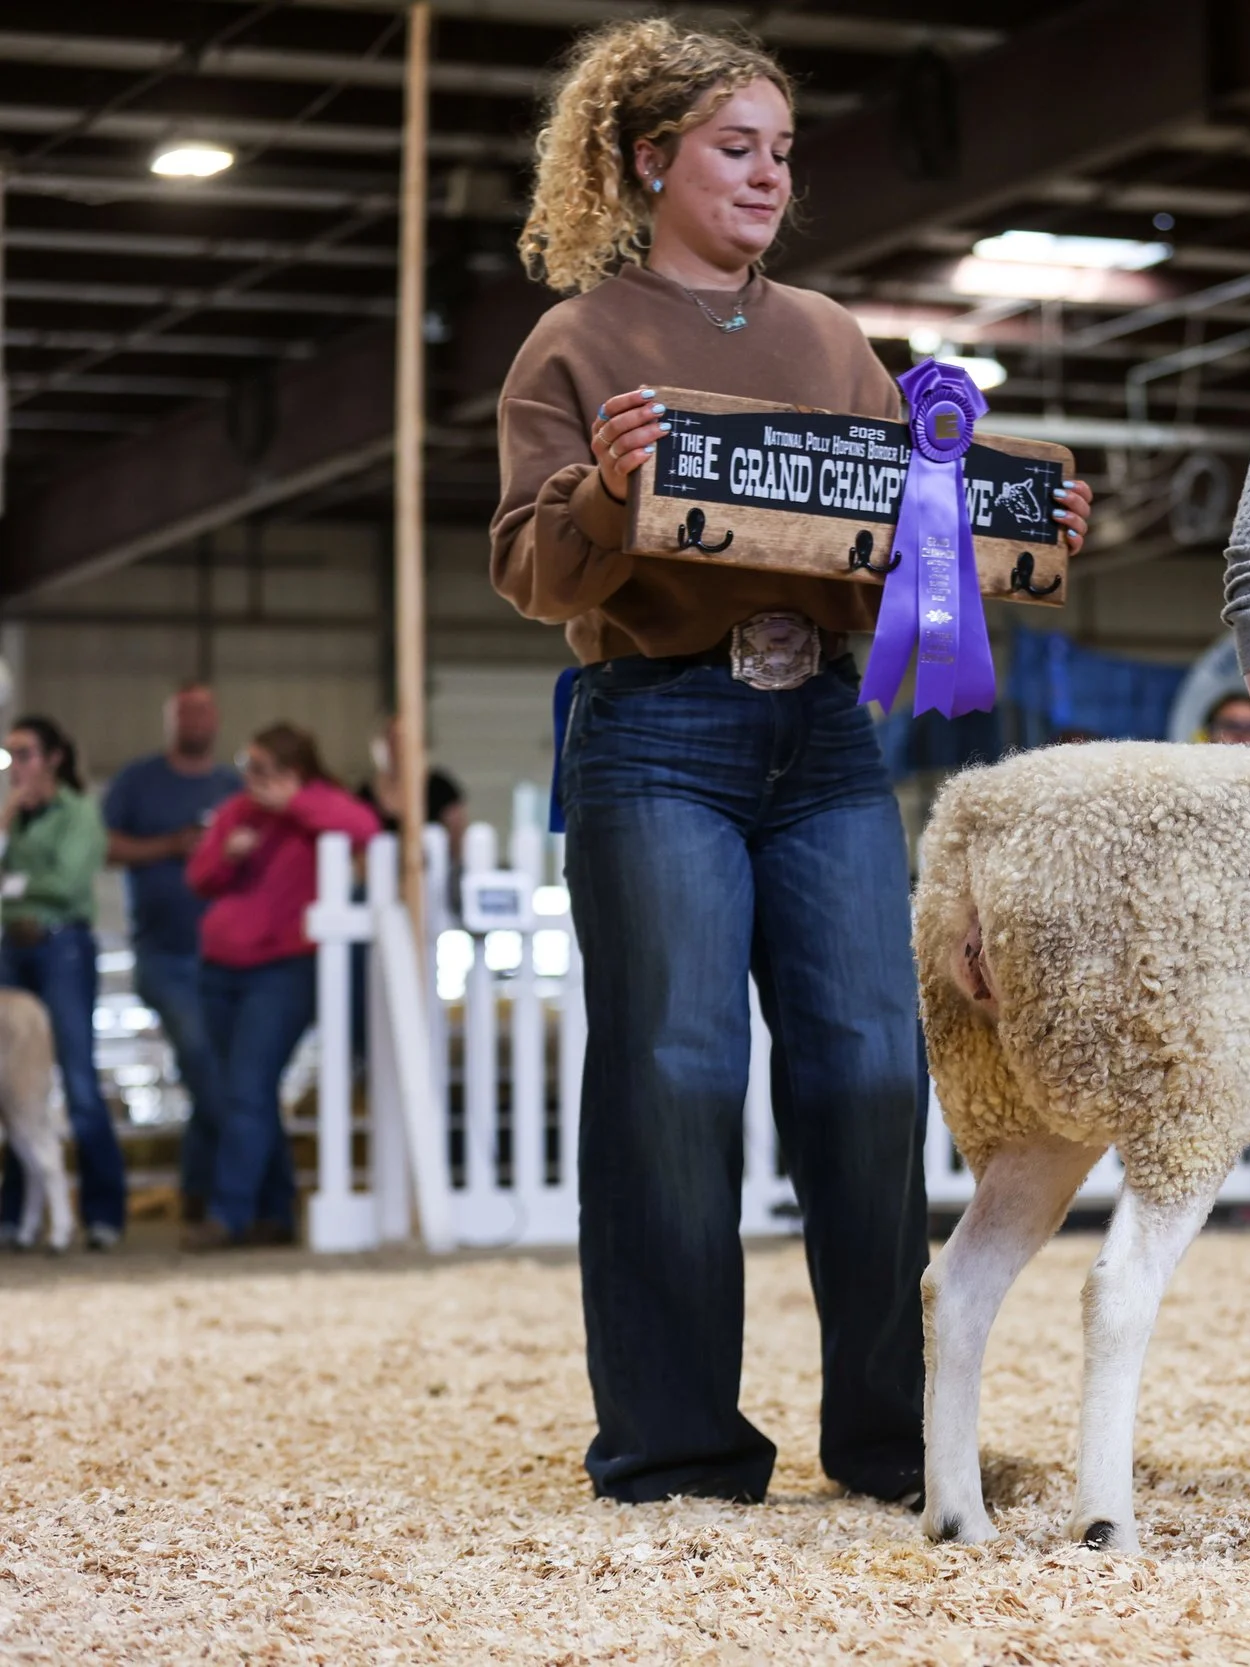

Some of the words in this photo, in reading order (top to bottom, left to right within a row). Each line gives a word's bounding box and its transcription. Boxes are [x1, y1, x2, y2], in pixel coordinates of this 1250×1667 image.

[680, 432, 704, 454] THE
[763, 425, 804, 449] NATIONAL
[805, 431, 831, 453] POLLY
[832, 435, 866, 458] HOPKINS
[867, 440, 899, 462] BORDER
[849, 425, 886, 442] 2025
[678, 453, 703, 478] BIG
[703, 436, 722, 480] E
[729, 447, 813, 503] GRAND
[819, 458, 908, 514] CHAMP
[962, 477, 994, 527] WE
